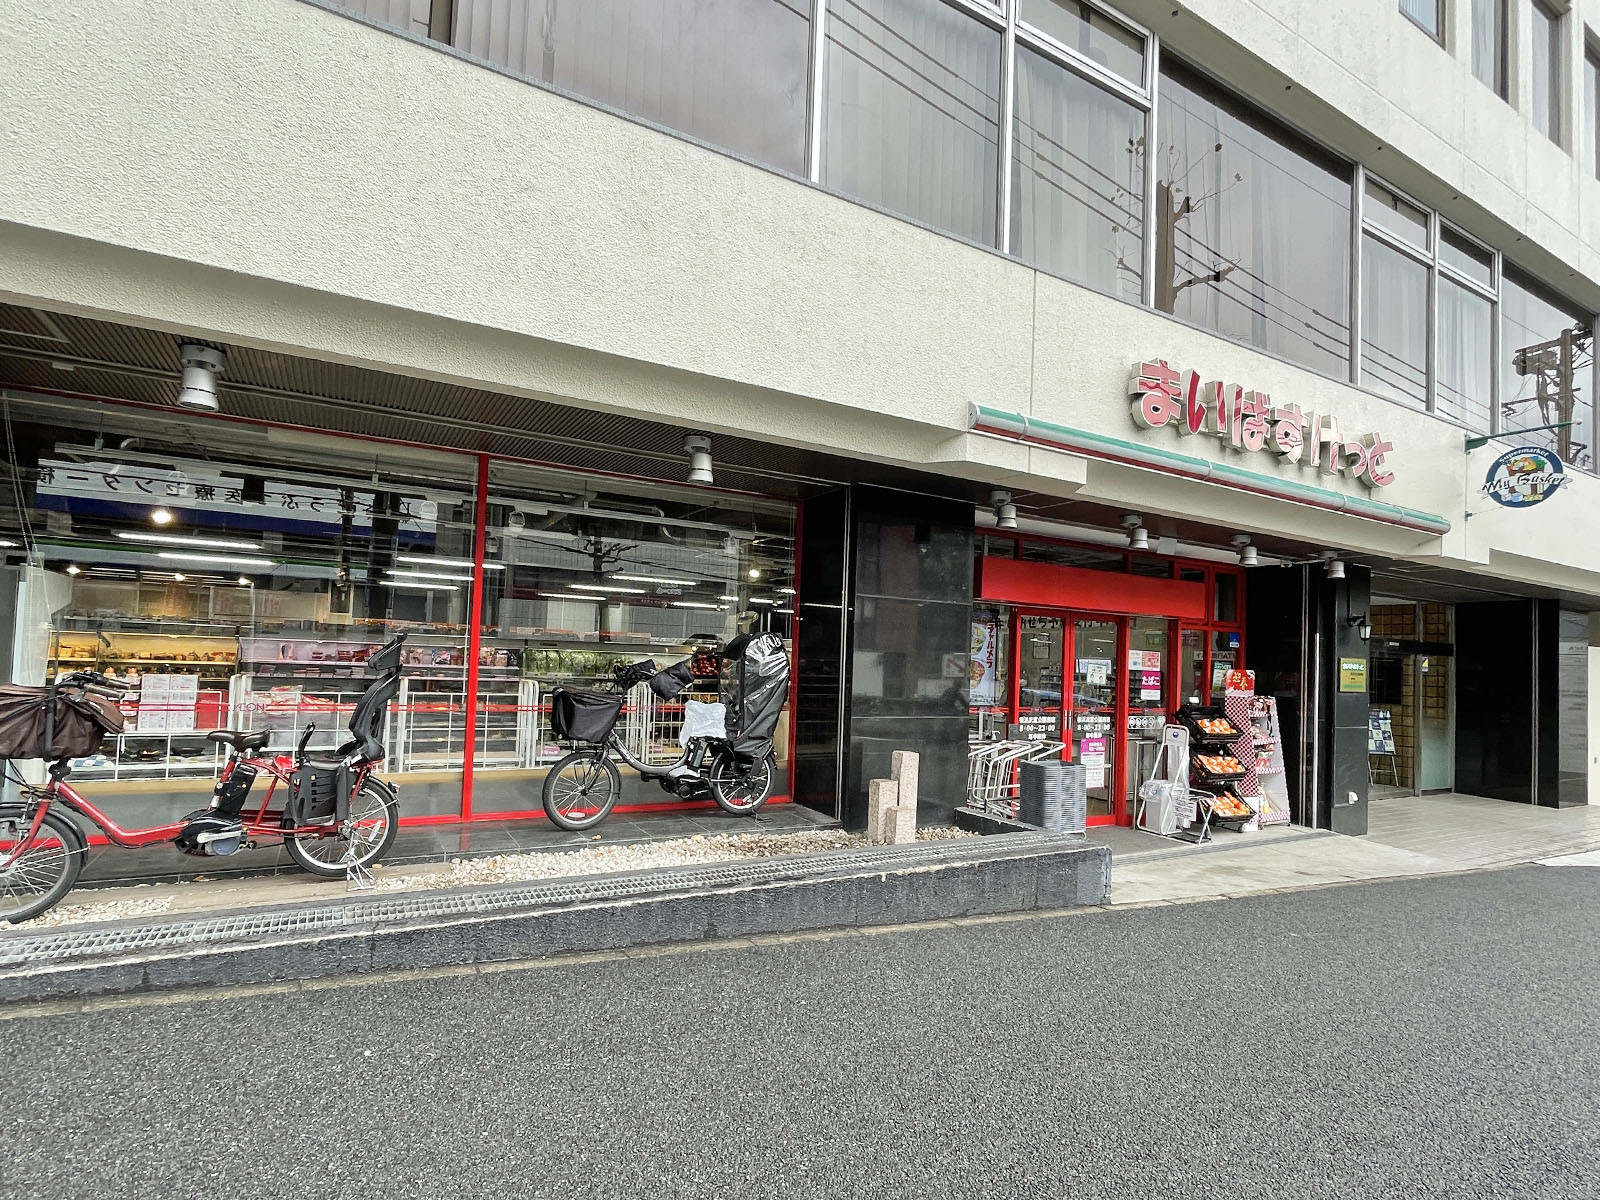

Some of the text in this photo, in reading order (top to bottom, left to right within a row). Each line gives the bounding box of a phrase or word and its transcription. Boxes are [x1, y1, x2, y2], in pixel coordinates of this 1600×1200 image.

[1129, 358, 1396, 488] まいばすけっと
[1499, 447, 1549, 463] Supermarket
[1482, 473, 1565, 493] My Basket
[986, 623, 995, 669] チャルメラ
[1141, 675, 1161, 686] たばこ
